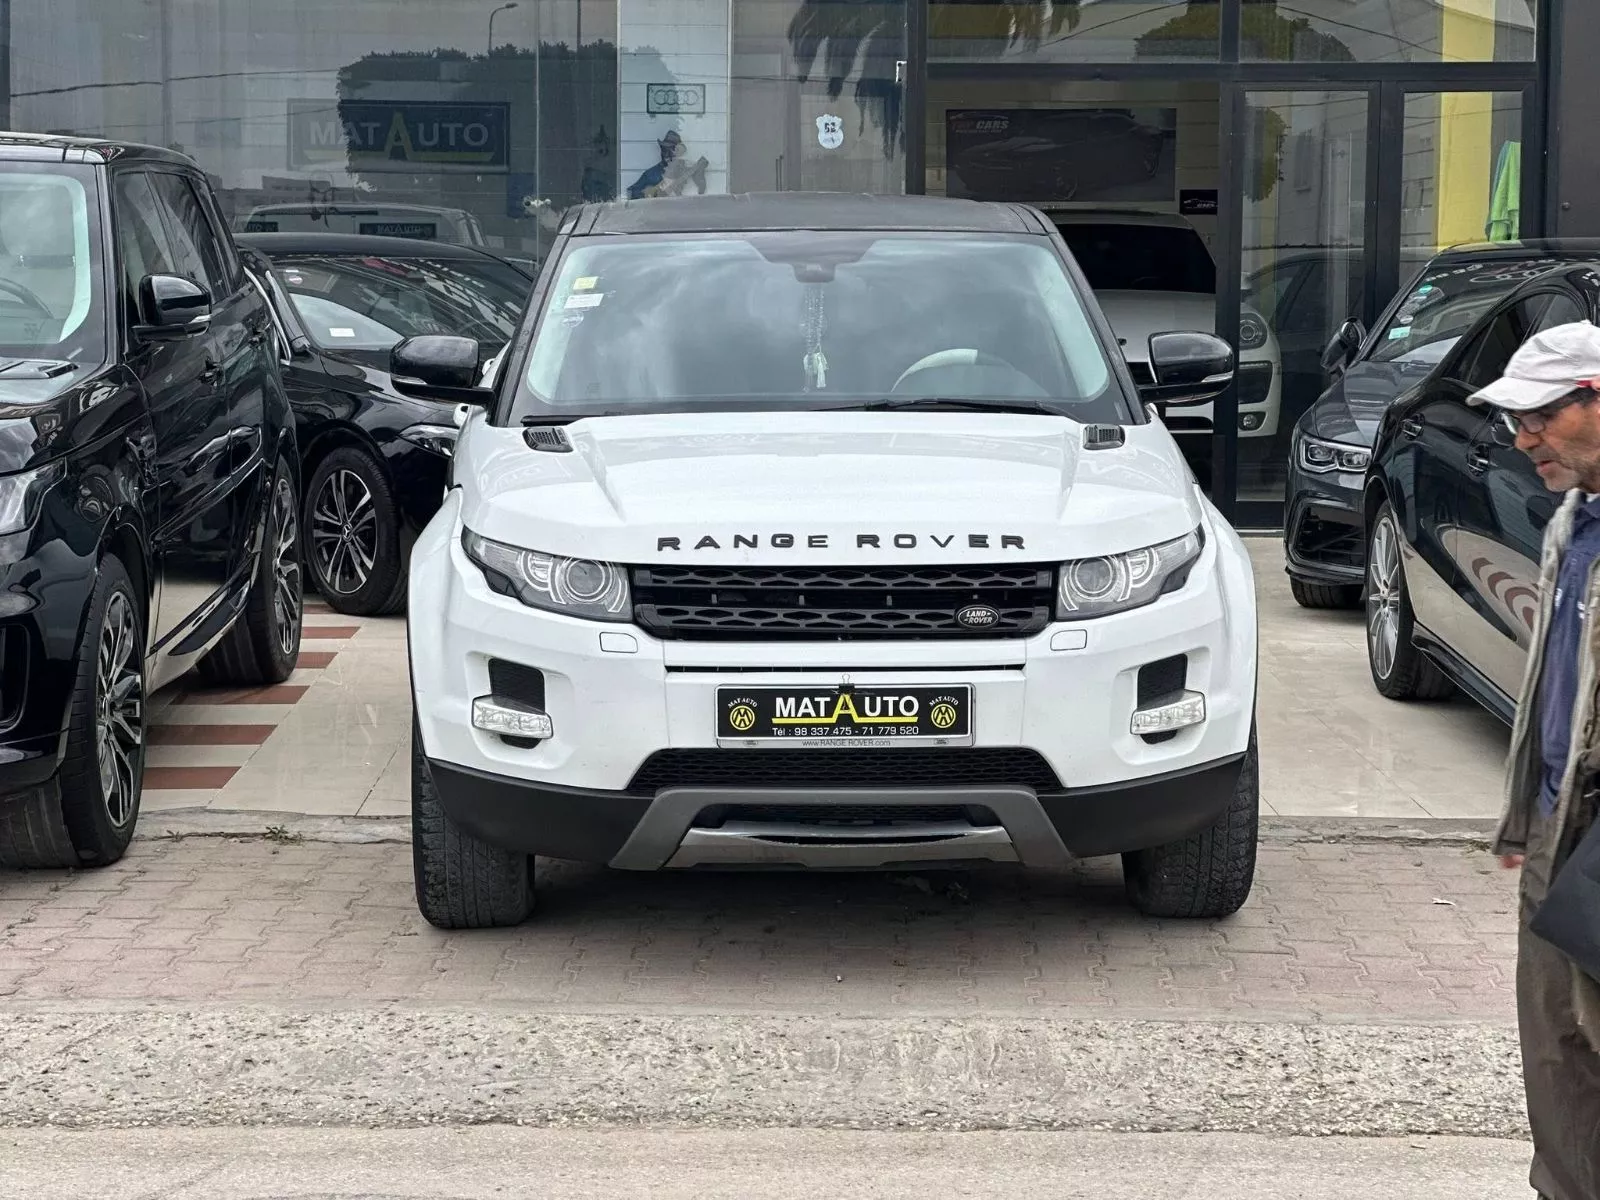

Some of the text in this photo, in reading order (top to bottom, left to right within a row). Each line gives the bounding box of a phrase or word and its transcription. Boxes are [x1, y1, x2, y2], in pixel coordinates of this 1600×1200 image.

[657, 533, 1025, 552] RANGE ROVER
[794, 727, 808, 736] 98
[811, 727, 829, 736] 337
[833, 727, 852, 735] 475
[862, 727, 874, 735] 71
[878, 726, 897, 735] 779
[900, 726, 919, 735] 520
